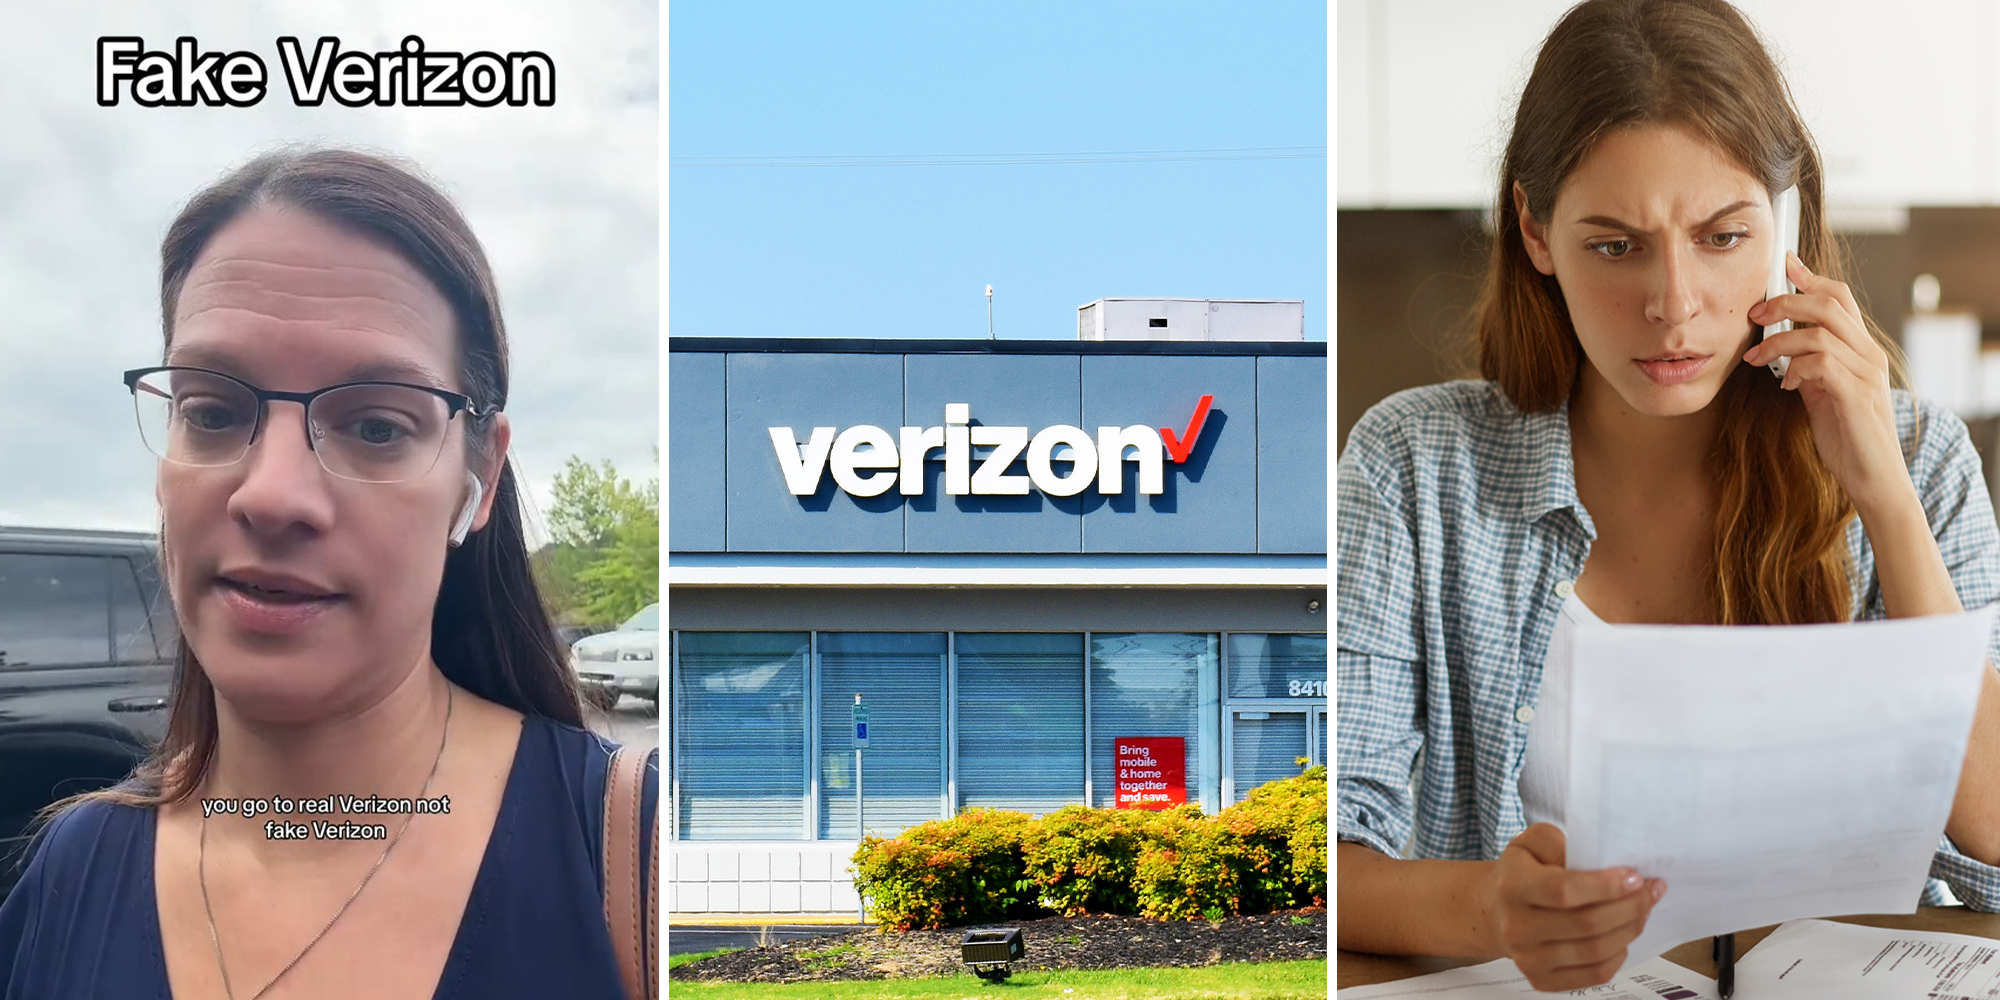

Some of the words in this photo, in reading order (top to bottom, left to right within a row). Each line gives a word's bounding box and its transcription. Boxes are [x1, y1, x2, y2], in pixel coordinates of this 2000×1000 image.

[768, 403, 1164, 497] verizon
[1120, 745, 1149, 757] Bring
[1120, 757, 1157, 767] mobile
[1120, 769, 1128, 778] &
[1130, 769, 1161, 778] home
[1120, 780, 1167, 792] together
[1120, 792, 1141, 802] and
[1142, 794, 1171, 802] save.
